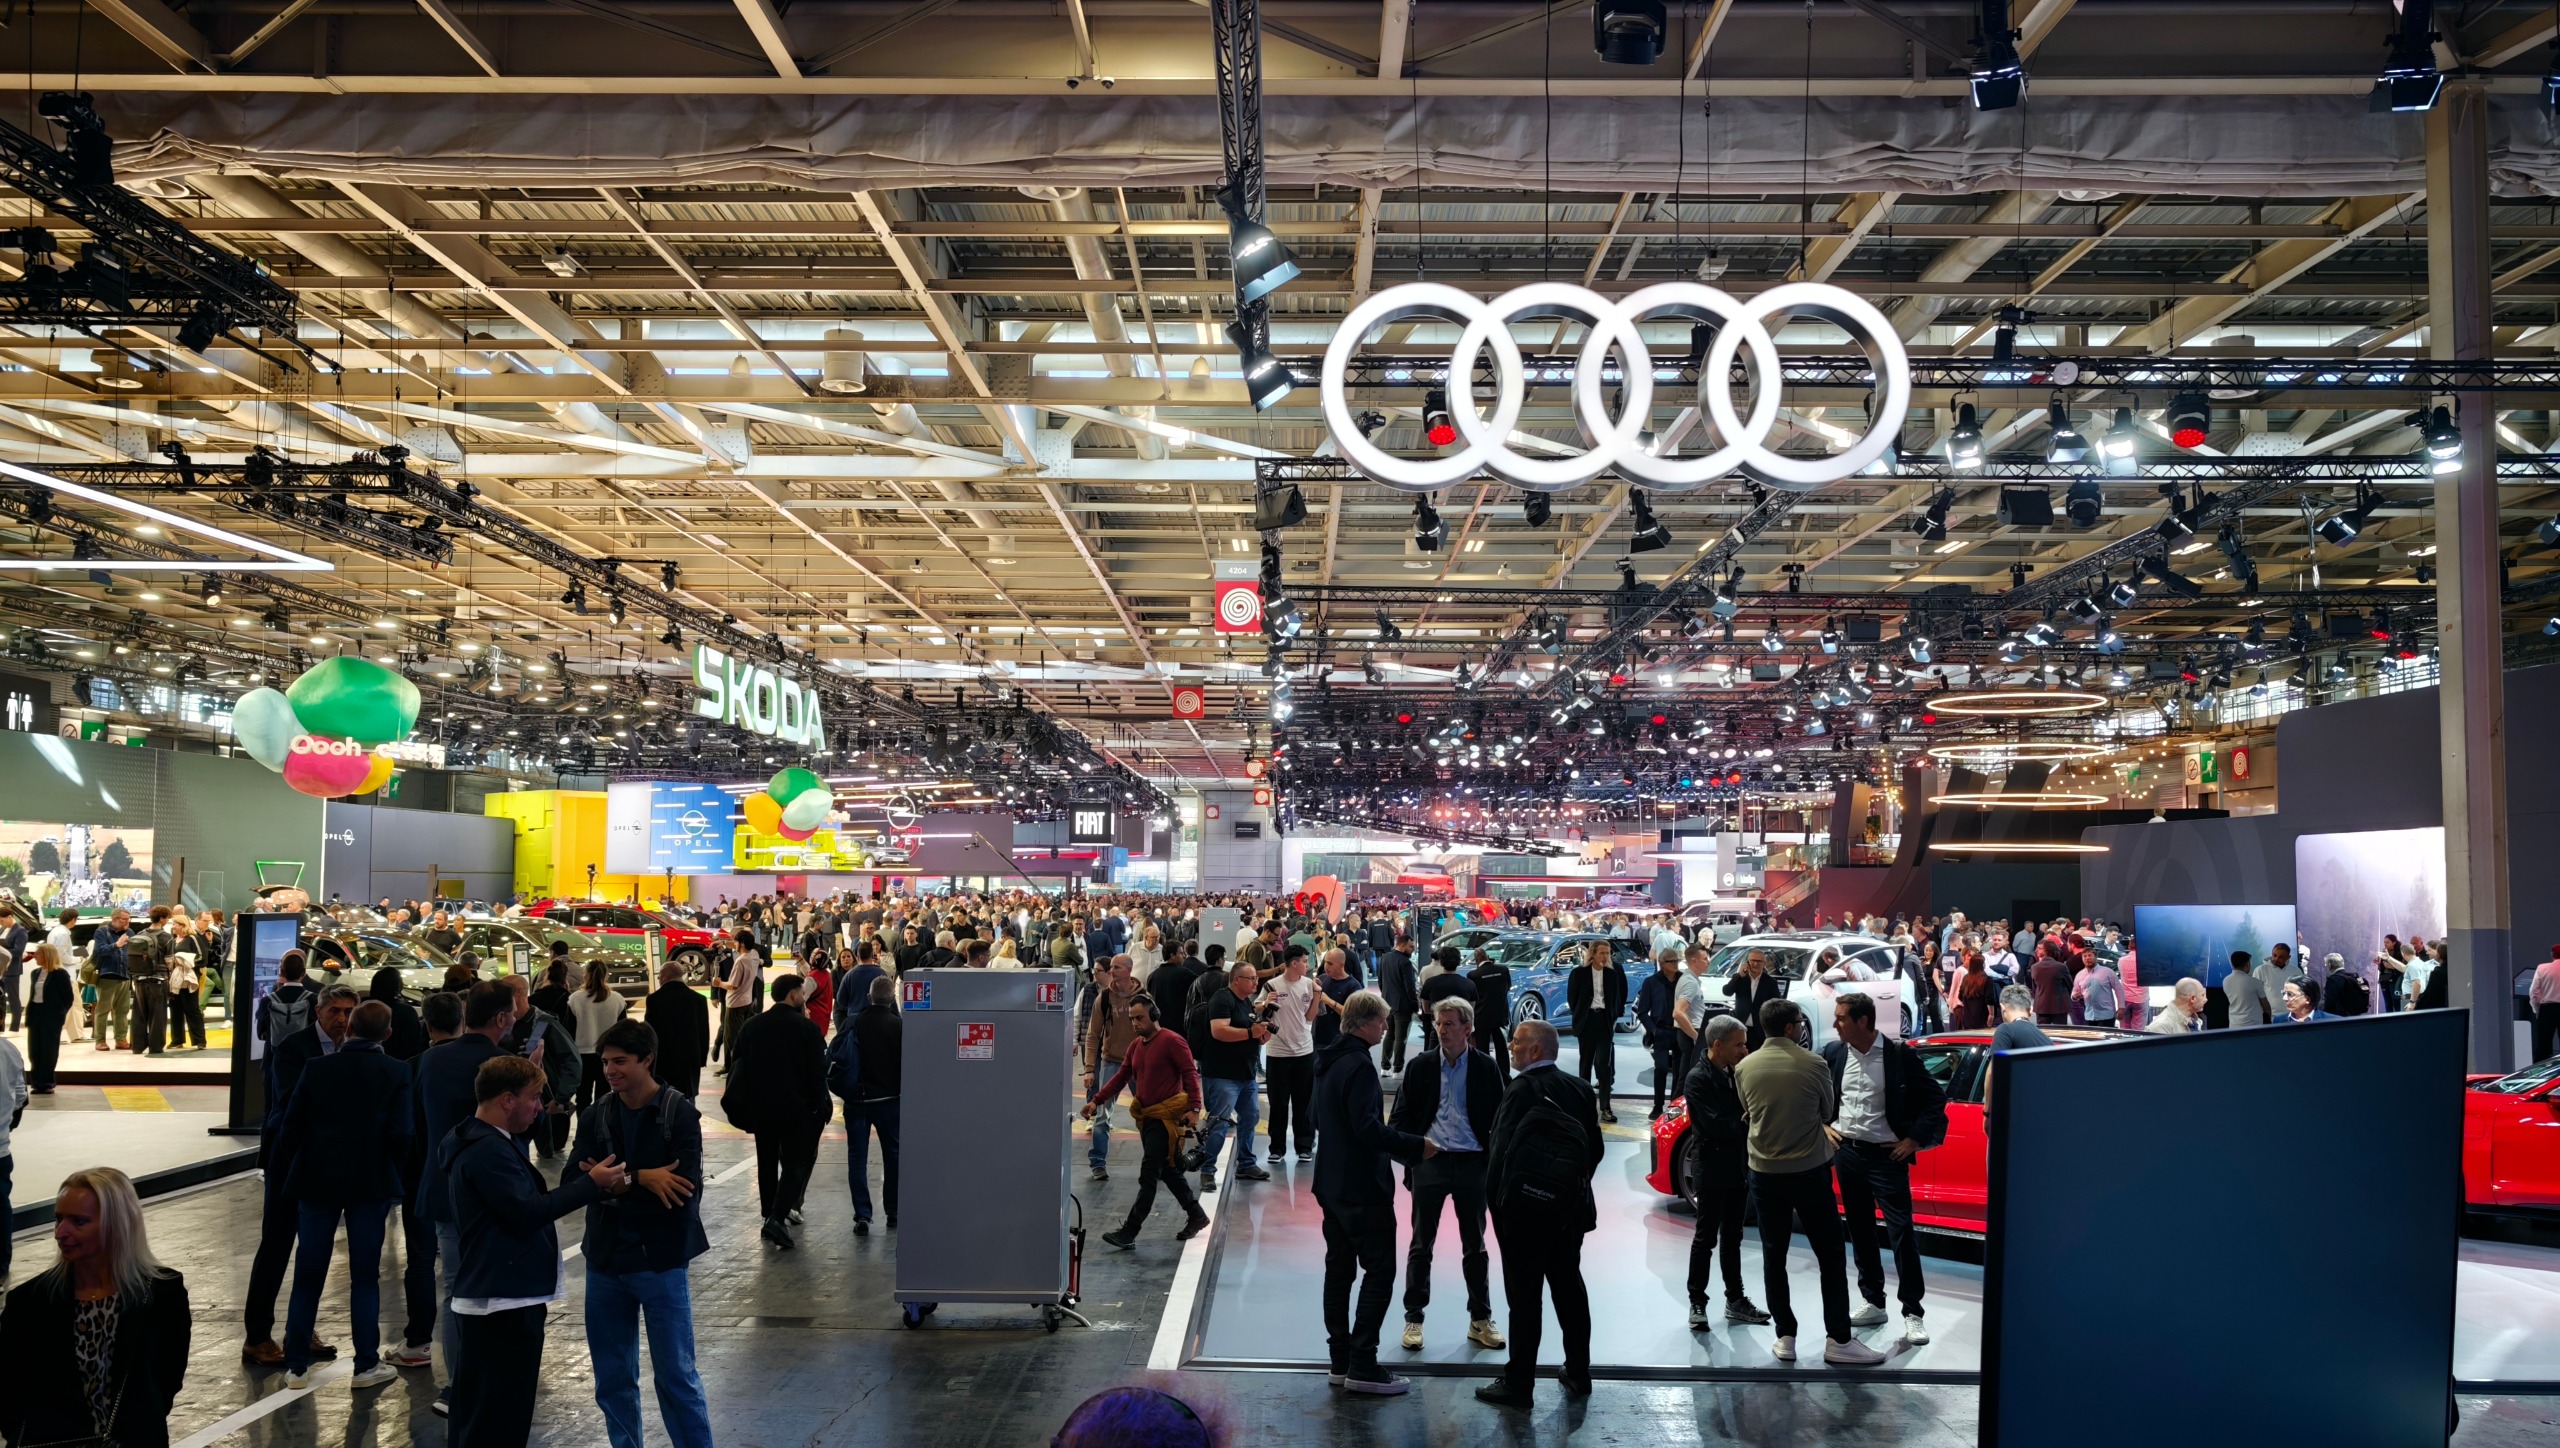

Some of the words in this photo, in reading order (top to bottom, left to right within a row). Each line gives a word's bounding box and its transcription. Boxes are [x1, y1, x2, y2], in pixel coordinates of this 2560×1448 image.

[1228, 567, 1248, 575] 4204
[290, 734, 362, 756] Oooh
[1075, 811, 1105, 835] FIAT
[674, 839, 712, 847] OPEL
[877, 834, 925, 846] OPEL
